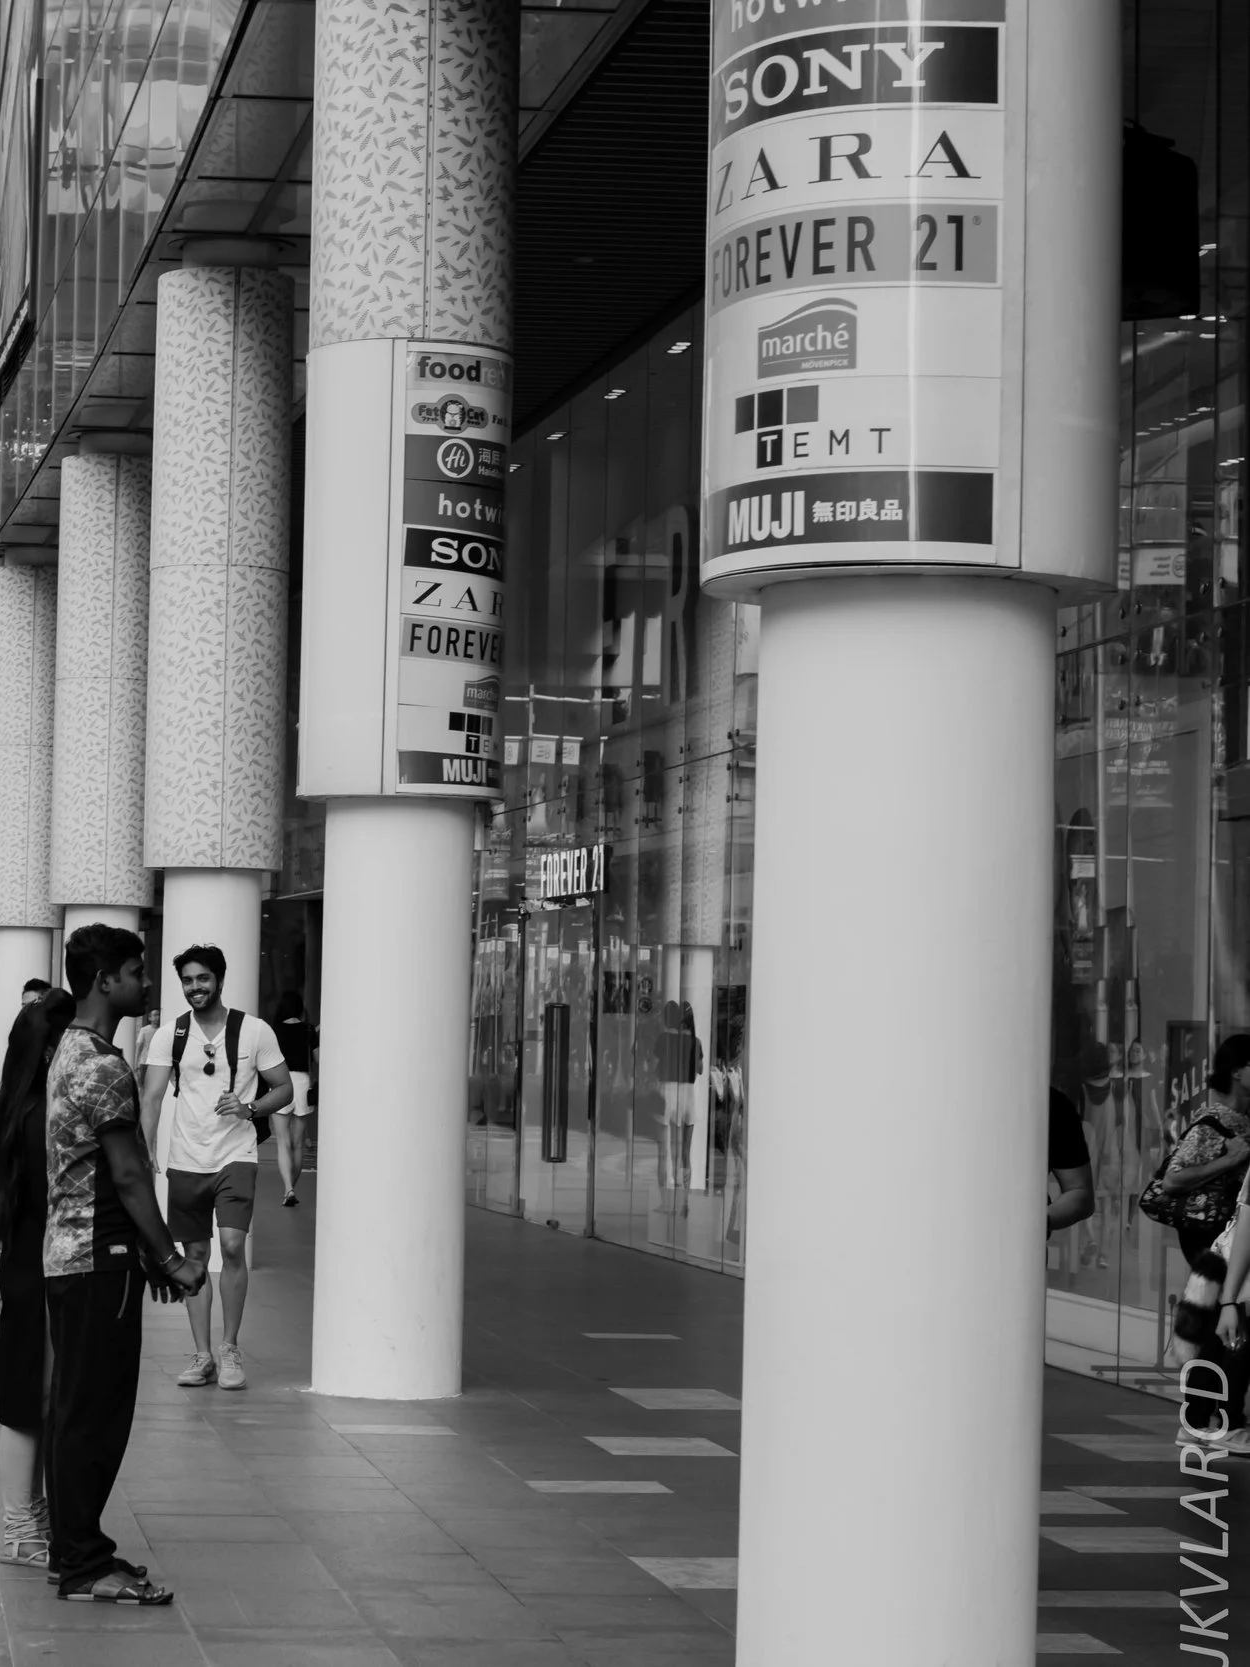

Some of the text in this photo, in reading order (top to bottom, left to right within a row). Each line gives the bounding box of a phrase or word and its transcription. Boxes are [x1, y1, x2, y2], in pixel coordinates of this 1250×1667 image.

[724, 42, 945, 124] SONY
[714, 130, 982, 216] ZARA
[711, 216, 876, 306] FOREVER
[761, 323, 850, 359] marché
[418, 405, 485, 421] Fat Cat
[445, 446, 467, 469] Hi
[761, 427, 892, 464] TEMT
[728, 491, 805, 545] MUJI
[812, 499, 903, 523] 無印良品
[409, 623, 501, 665] FOREVE
[443, 758, 487, 784] MUJI
[540, 844, 605, 898] FOREVER 21
